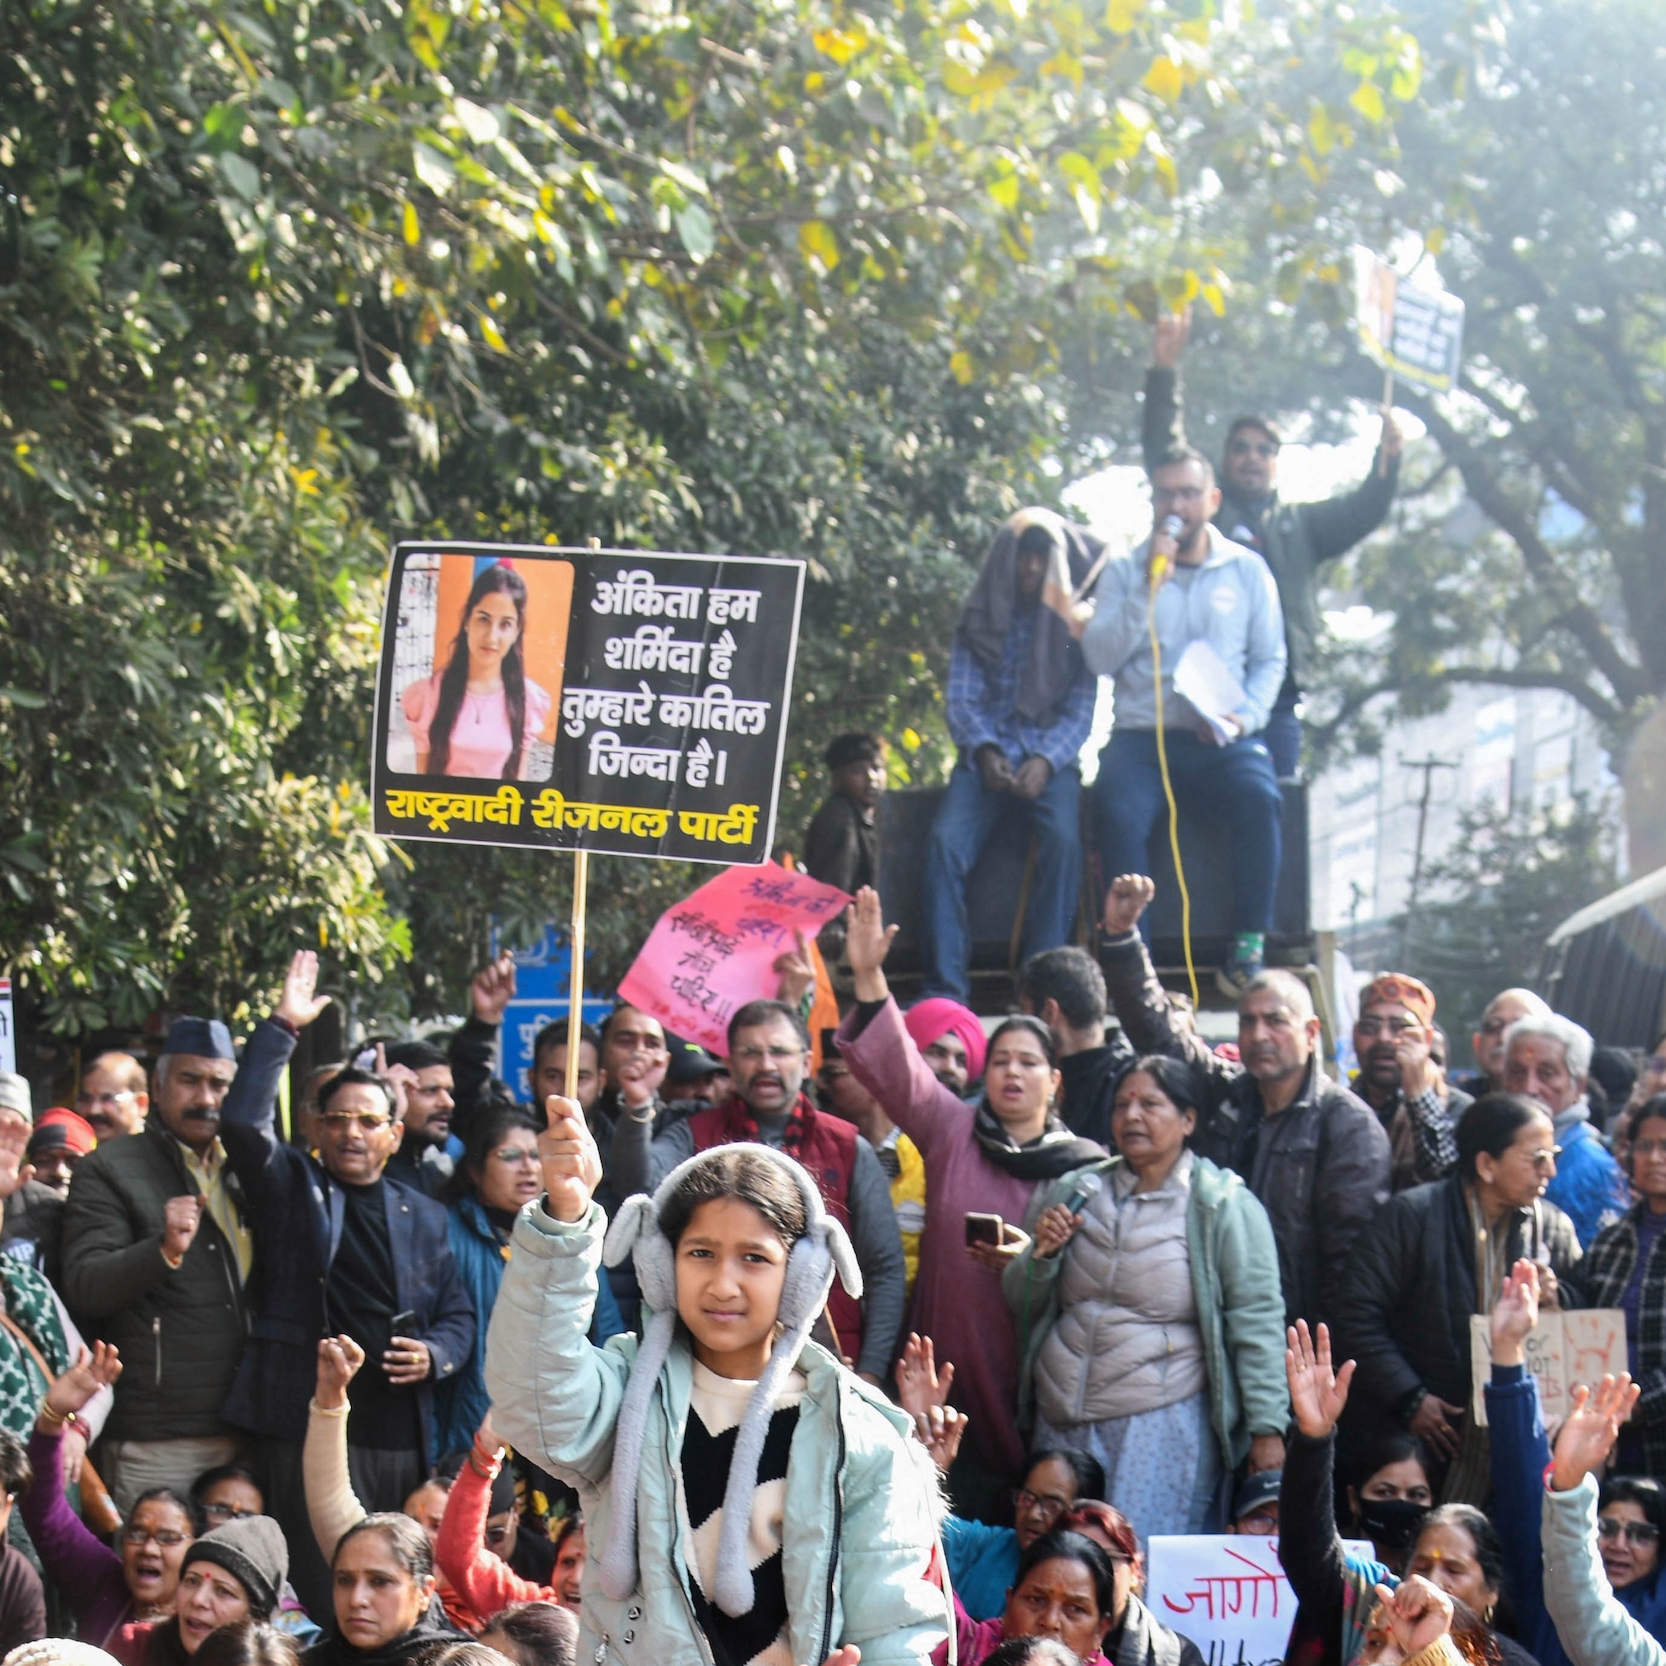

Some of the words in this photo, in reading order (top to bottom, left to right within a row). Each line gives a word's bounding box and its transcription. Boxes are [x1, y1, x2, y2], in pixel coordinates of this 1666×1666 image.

[590, 569, 703, 619] अंकिता
[706, 588, 762, 625] हम
[708, 628, 738, 680] है
[562, 680, 657, 738] तुम्हारे
[659, 683, 771, 735] कातिल
[588, 730, 682, 782] जिन्दा
[385, 785, 523, 833] राष्ट्रवादी
[531, 788, 672, 838] रीजनल
[678, 804, 759, 845] पार्टी
